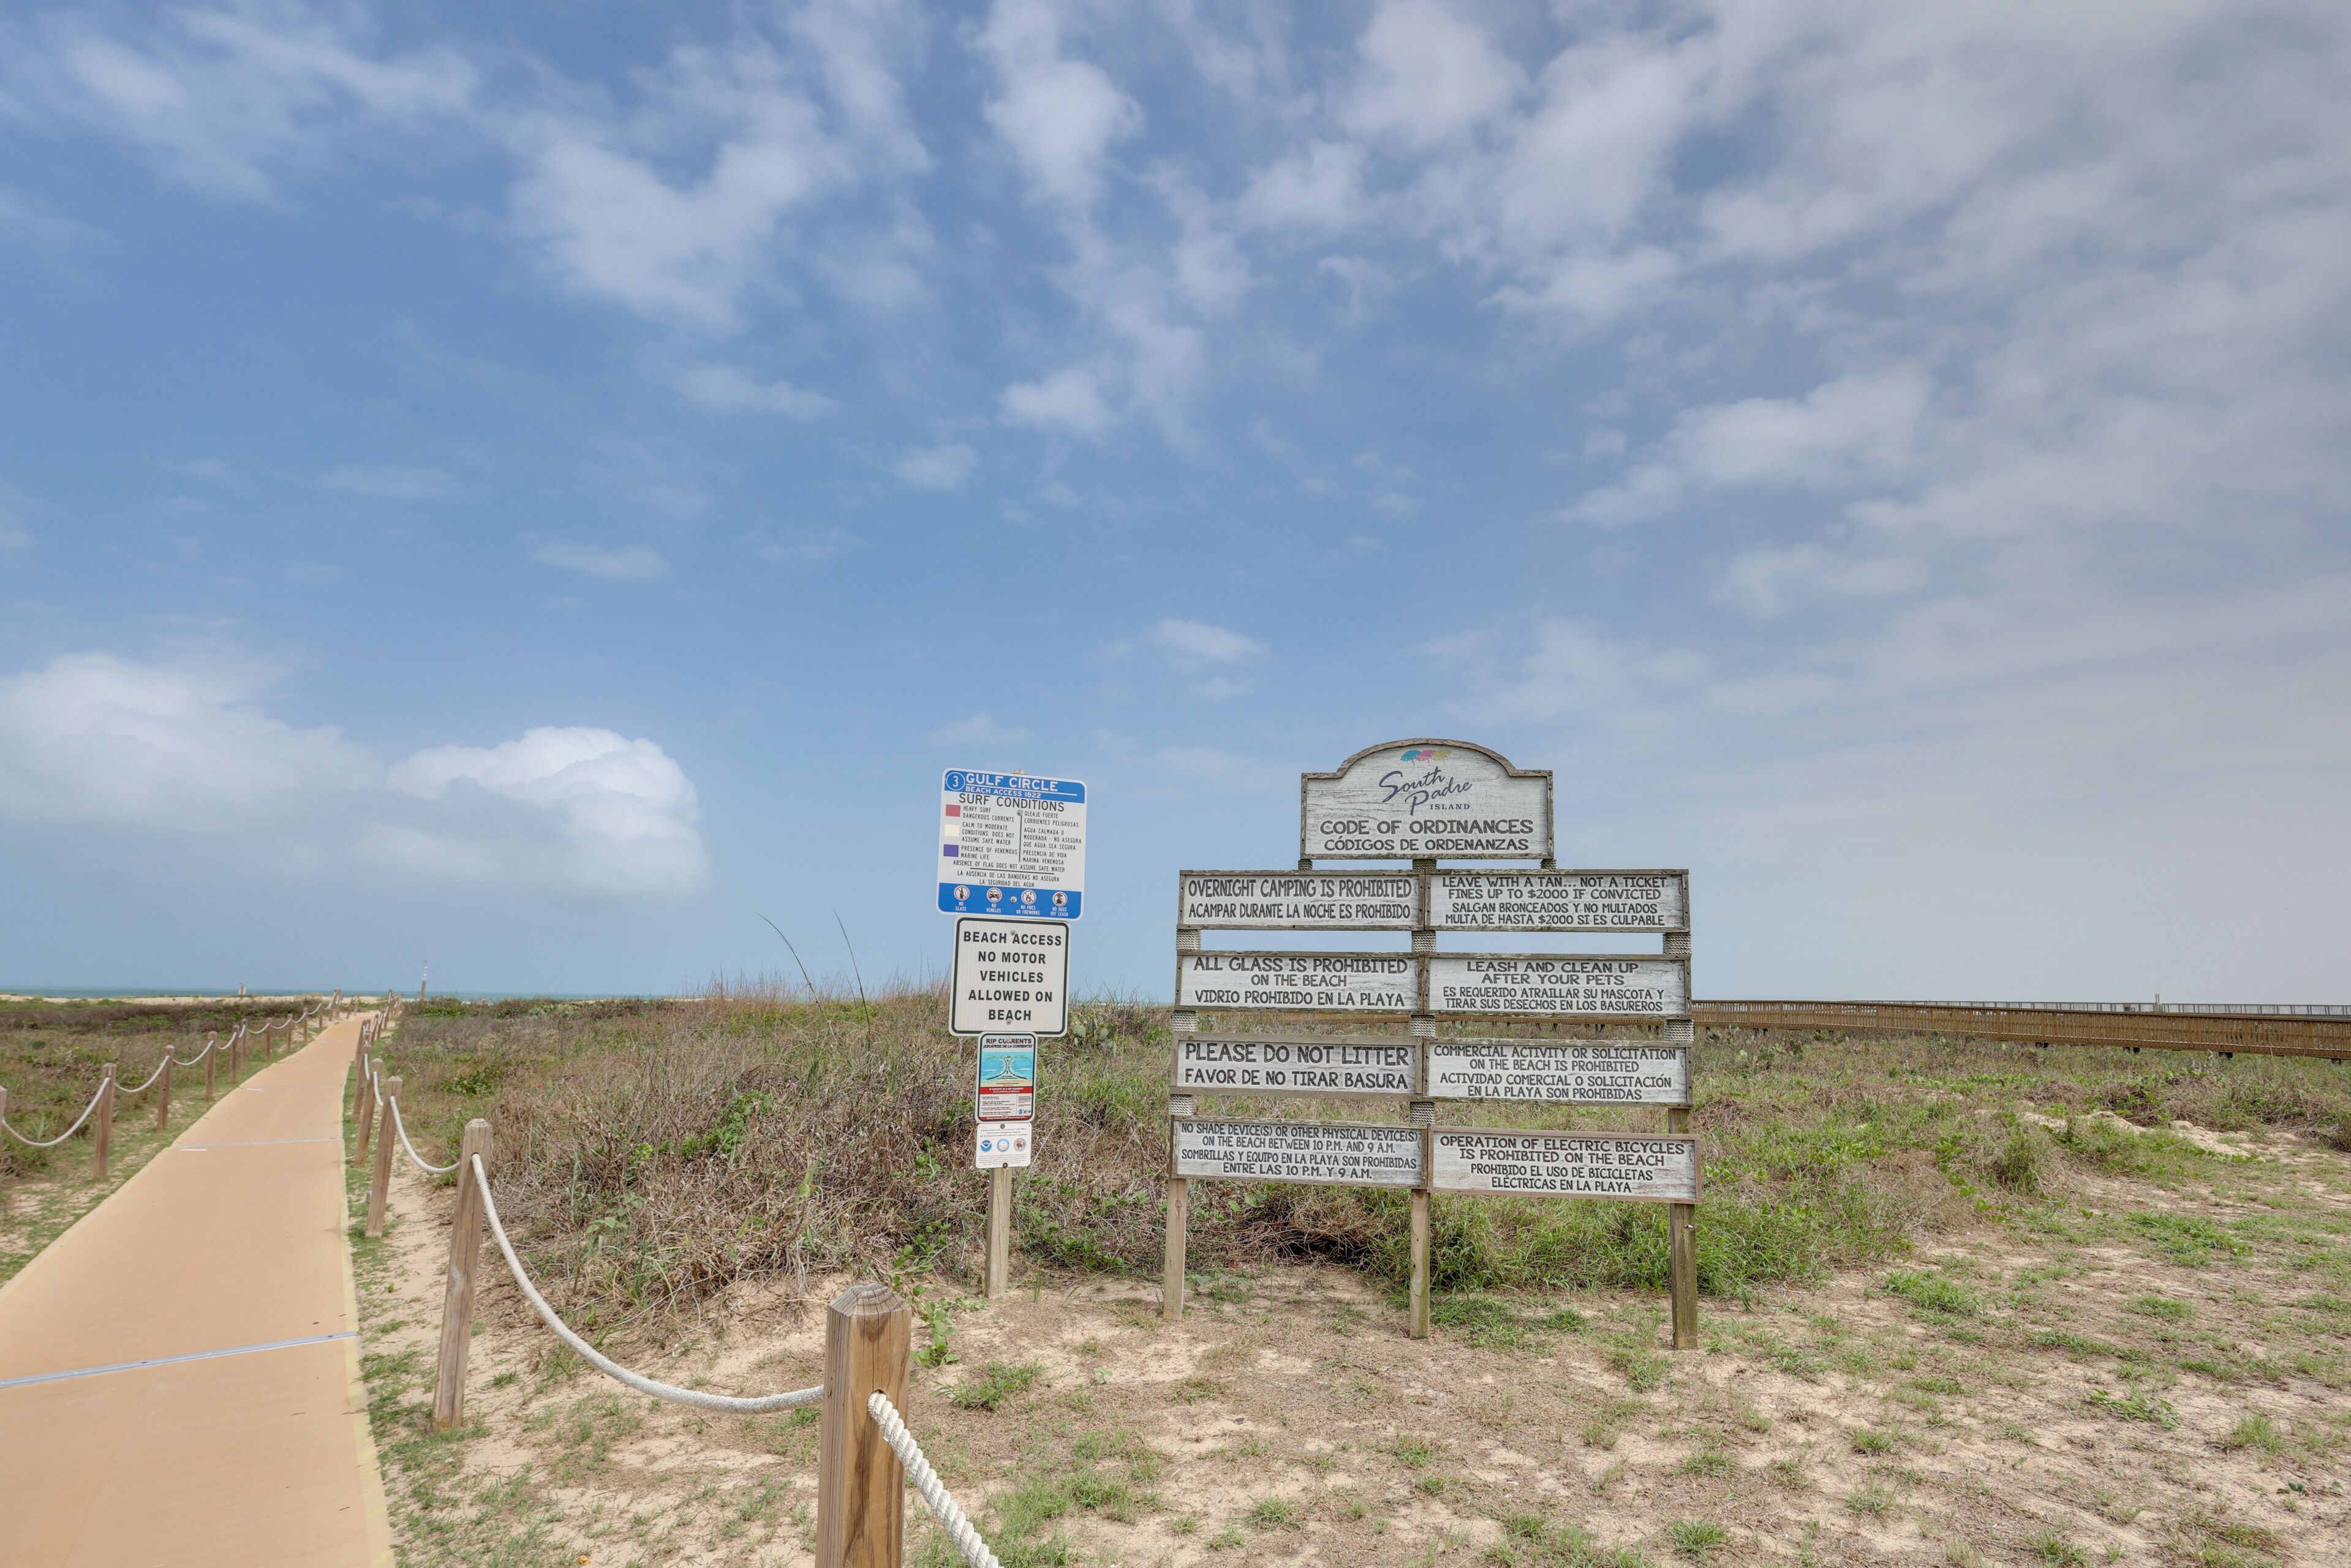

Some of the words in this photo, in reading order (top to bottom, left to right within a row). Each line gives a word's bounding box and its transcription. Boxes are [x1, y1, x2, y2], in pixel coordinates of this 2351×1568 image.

[953, 775, 959, 788] 3
[965, 772, 1003, 787] GULF
[1008, 776, 1058, 792] CIRCLE
[1378, 765, 1445, 803] South
[993, 788, 1022, 797] ACCESS
[1404, 777, 1473, 816] Padre
[959, 793, 990, 805] SURF
[996, 796, 1065, 812] CONDITIONS
[962, 812, 989, 821] DANGEROUS
[1320, 820, 1369, 834] CODE
[1376, 819, 1402, 834] OF
[1409, 819, 1533, 834] ORDINANCES
[1324, 836, 1394, 851] CÓDIGOS
[1399, 839, 1418, 851] DE
[1424, 839, 1529, 850] ORDENANZAS
[1188, 879, 1256, 897] OVERNIGHT
[1260, 879, 1316, 898] CAMPING
[1320, 879, 1334, 898] IS
[1338, 879, 1411, 898] PROHIBITED
[1442, 876, 1481, 888] LEAVE
[1487, 876, 1519, 888] WITH
[1523, 876, 1533, 888] A
[1538, 876, 1576, 888] TAN...
[1579, 876, 1603, 888] NOT
[1608, 876, 1618, 888] A
[1623, 876, 1666, 888] TICKET
[1448, 888, 1483, 899] FINES
[1487, 889, 1503, 899] UP
[1507, 889, 1523, 900] TO
[1527, 889, 1568, 900] $2000
[1573, 889, 1586, 900] IF
[1590, 889, 1661, 900] CONVICTED
[1188, 903, 1236, 918] ACAMPAR
[1239, 903, 1282, 918] DURANTE
[1286, 903, 1300, 918] LA
[1303, 903, 1335, 919] NOCHE
[1338, 903, 1352, 919] ES
[1355, 903, 1411, 919] PROHIBIDO
[963, 930, 1006, 944] BEACH
[1012, 933, 1062, 946] ACCESS
[978, 951, 995, 963] NO
[1001, 951, 1046, 964] MOTOR
[1193, 956, 1223, 971] ALL
[1228, 957, 1283, 972] GLASS
[1288, 957, 1307, 973] IS
[1312, 958, 1407, 974] PROHIBITED
[1467, 961, 1517, 973] LEASH
[1524, 962, 1555, 973] AND
[1560, 962, 1613, 973] CLEAN
[1618, 963, 1639, 973] UP
[979, 970, 1043, 983] VEHICLES
[1250, 974, 1269, 986] ON
[1274, 974, 1297, 987] THE
[1302, 974, 1347, 987] BEACH
[1481, 973, 1530, 985] AFTER
[1538, 973, 1579, 985] YOUR
[1585, 974, 1625, 986] PETS
[968, 989, 1029, 1001] ALLOWED
[1035, 991, 1052, 1002] ON
[1194, 990, 1240, 1004] VIDRIO
[1244, 990, 1313, 1005] PROHIBIDO
[1317, 992, 1334, 1006] EN
[1337, 992, 1354, 1006] LA
[1359, 992, 1405, 1007] PLAYA
[988, 1009, 1032, 1021] BEACH
[1185, 1043, 1256, 1063] PLEASE
[1263, 1044, 1289, 1063] DO
[1297, 1045, 1334, 1065] NOT
[1341, 1046, 1409, 1066] LITTER
[1434, 1044, 1507, 1058] COMMERCIAL
[1511, 1046, 1566, 1058] ACTIVITY
[1571, 1047, 1587, 1059] OR
[1591, 1047, 1677, 1060] SOLICITATION
[1469, 1058, 1485, 1070] ON
[1490, 1059, 1508, 1071] THE
[1512, 1059, 1550, 1071] BEACH
[1554, 1060, 1568, 1072] IS
[1571, 1060, 1639, 1073] PROHIBITED
[1185, 1068, 1236, 1085] FAVOR
[1241, 1069, 1259, 1085] DE
[1265, 1070, 1286, 1086] NO
[1291, 1071, 1340, 1087] TIRAR
[1344, 1072, 1408, 1089] BASURA
[1440, 1072, 1502, 1085] ACTIVIDAD
[1505, 1074, 1570, 1086] COMERCIAL
[1574, 1075, 1583, 1087] O
[1587, 1072, 1672, 1088] SOLICITACIÓN
[1181, 1123, 1193, 1134] NO
[1196, 1123, 1225, 1135] SHADE
[1228, 1124, 1272, 1137] DEVICE(S)
[1275, 1126, 1288, 1137] OR
[1290, 1126, 1319, 1138] OTHER
[1321, 1127, 1369, 1140] PHYSICAL
[1370, 1129, 1417, 1142] DEVICE(S)
[1440, 1135, 1517, 1149] OPERATION
[1520, 1138, 1538, 1150] OF
[1544, 1139, 1610, 1153] ELECTRIC
[1615, 1141, 1685, 1155] BICYCLES
[1459, 1147, 1474, 1160] IS
[1479, 1148, 1559, 1163] PROHIBITED
[1564, 1151, 1583, 1164] ON
[1589, 1152, 1612, 1165] THE
[1617, 1153, 1664, 1166] BEACH
